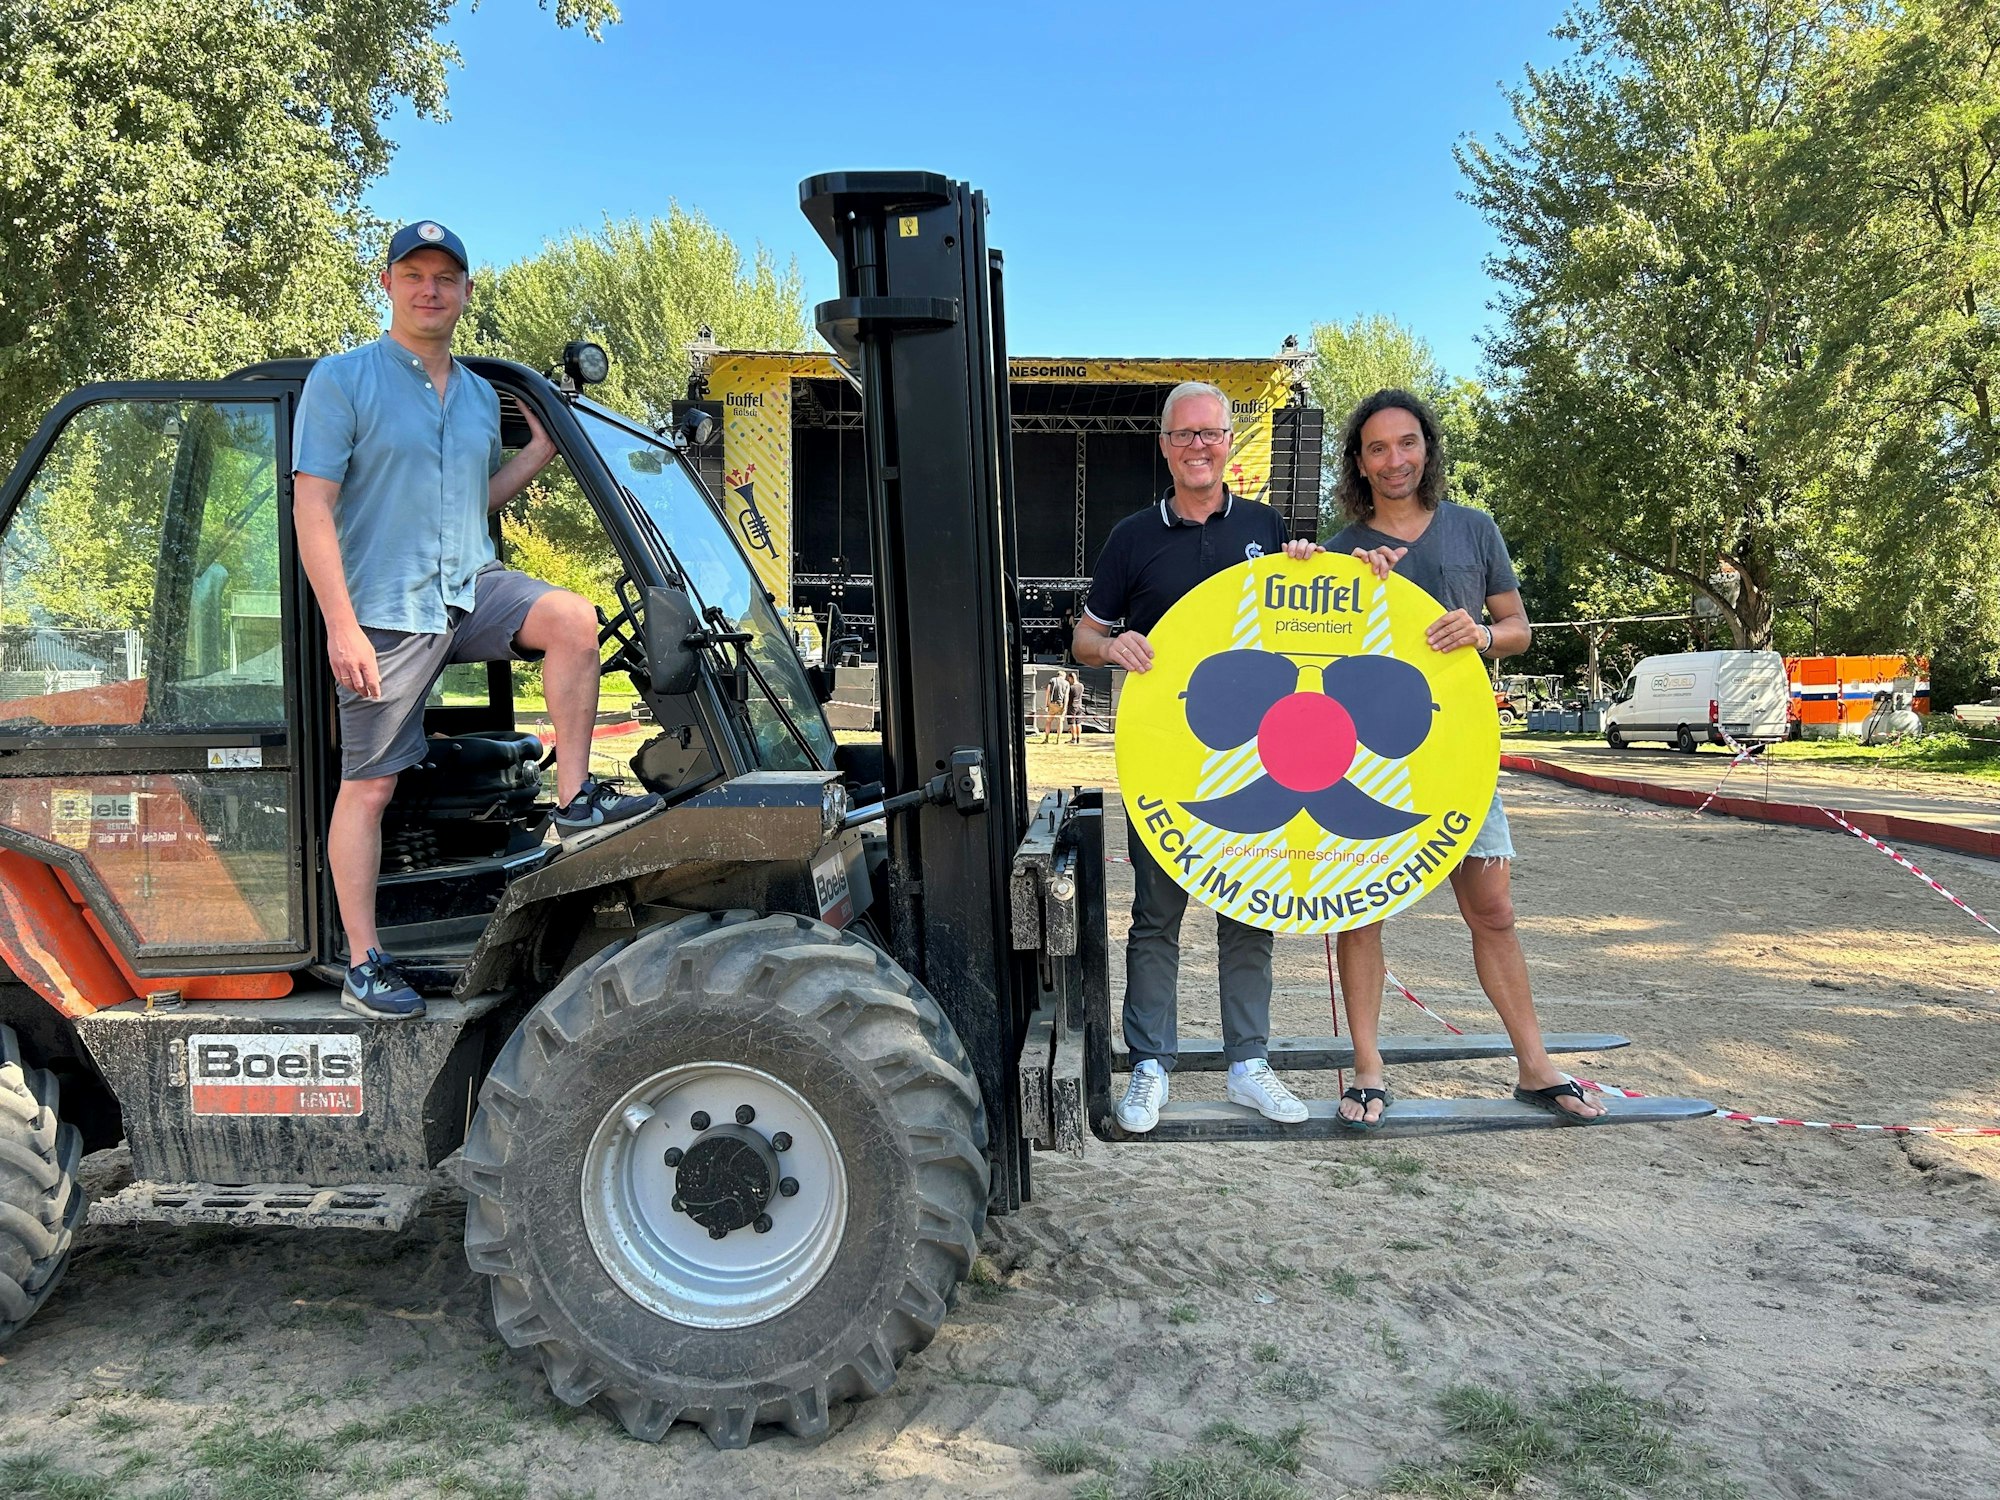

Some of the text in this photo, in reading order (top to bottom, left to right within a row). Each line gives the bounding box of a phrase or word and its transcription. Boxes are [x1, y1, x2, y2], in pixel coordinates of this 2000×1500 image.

[726, 391, 764, 407] Gaffel
[1232, 398, 1270, 414] Gaffel
[1264, 573, 1364, 615] Gaffel
[1275, 619, 1353, 635] präsentiert
[1137, 794, 1472, 921] JECK IM SUNNESCHING
[1221, 843, 1390, 867] jeckimsunnesching.de
[815, 863, 847, 907] Boels
[198, 1044, 351, 1078] Boels
[300, 1092, 354, 1108] RENTAL
